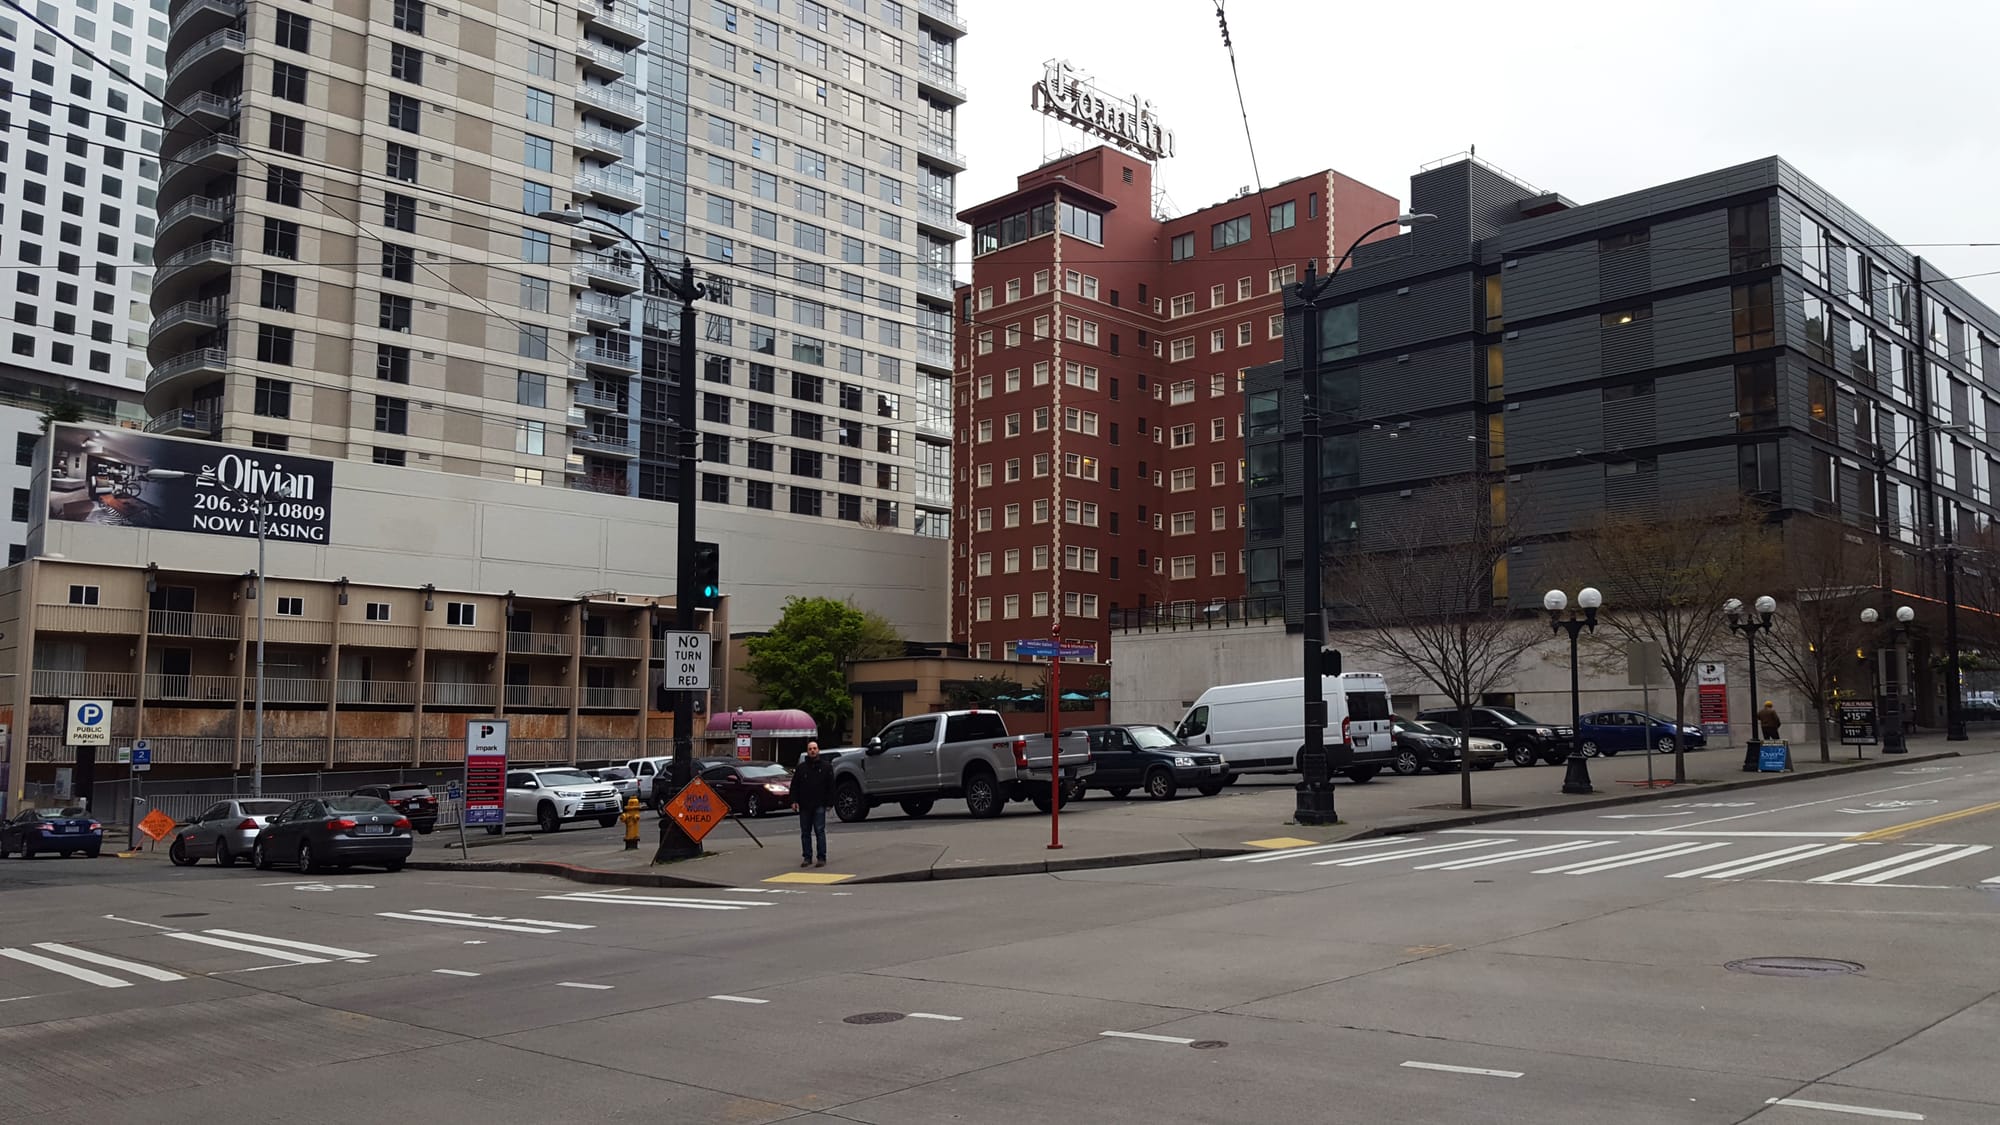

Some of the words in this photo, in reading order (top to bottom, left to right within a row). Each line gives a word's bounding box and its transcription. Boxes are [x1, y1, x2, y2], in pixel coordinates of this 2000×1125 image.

[217, 454, 315, 500] Olivian
[193, 514, 244, 534] NOW
[249, 519, 324, 541] LEASING
[678, 636, 699, 648] NO
[675, 650, 702, 660] TURN
[681, 663, 695, 673] ON
[678, 676, 698, 686] RED
[138, 751, 145, 759] 2
[684, 815, 712, 823] AHEAD
